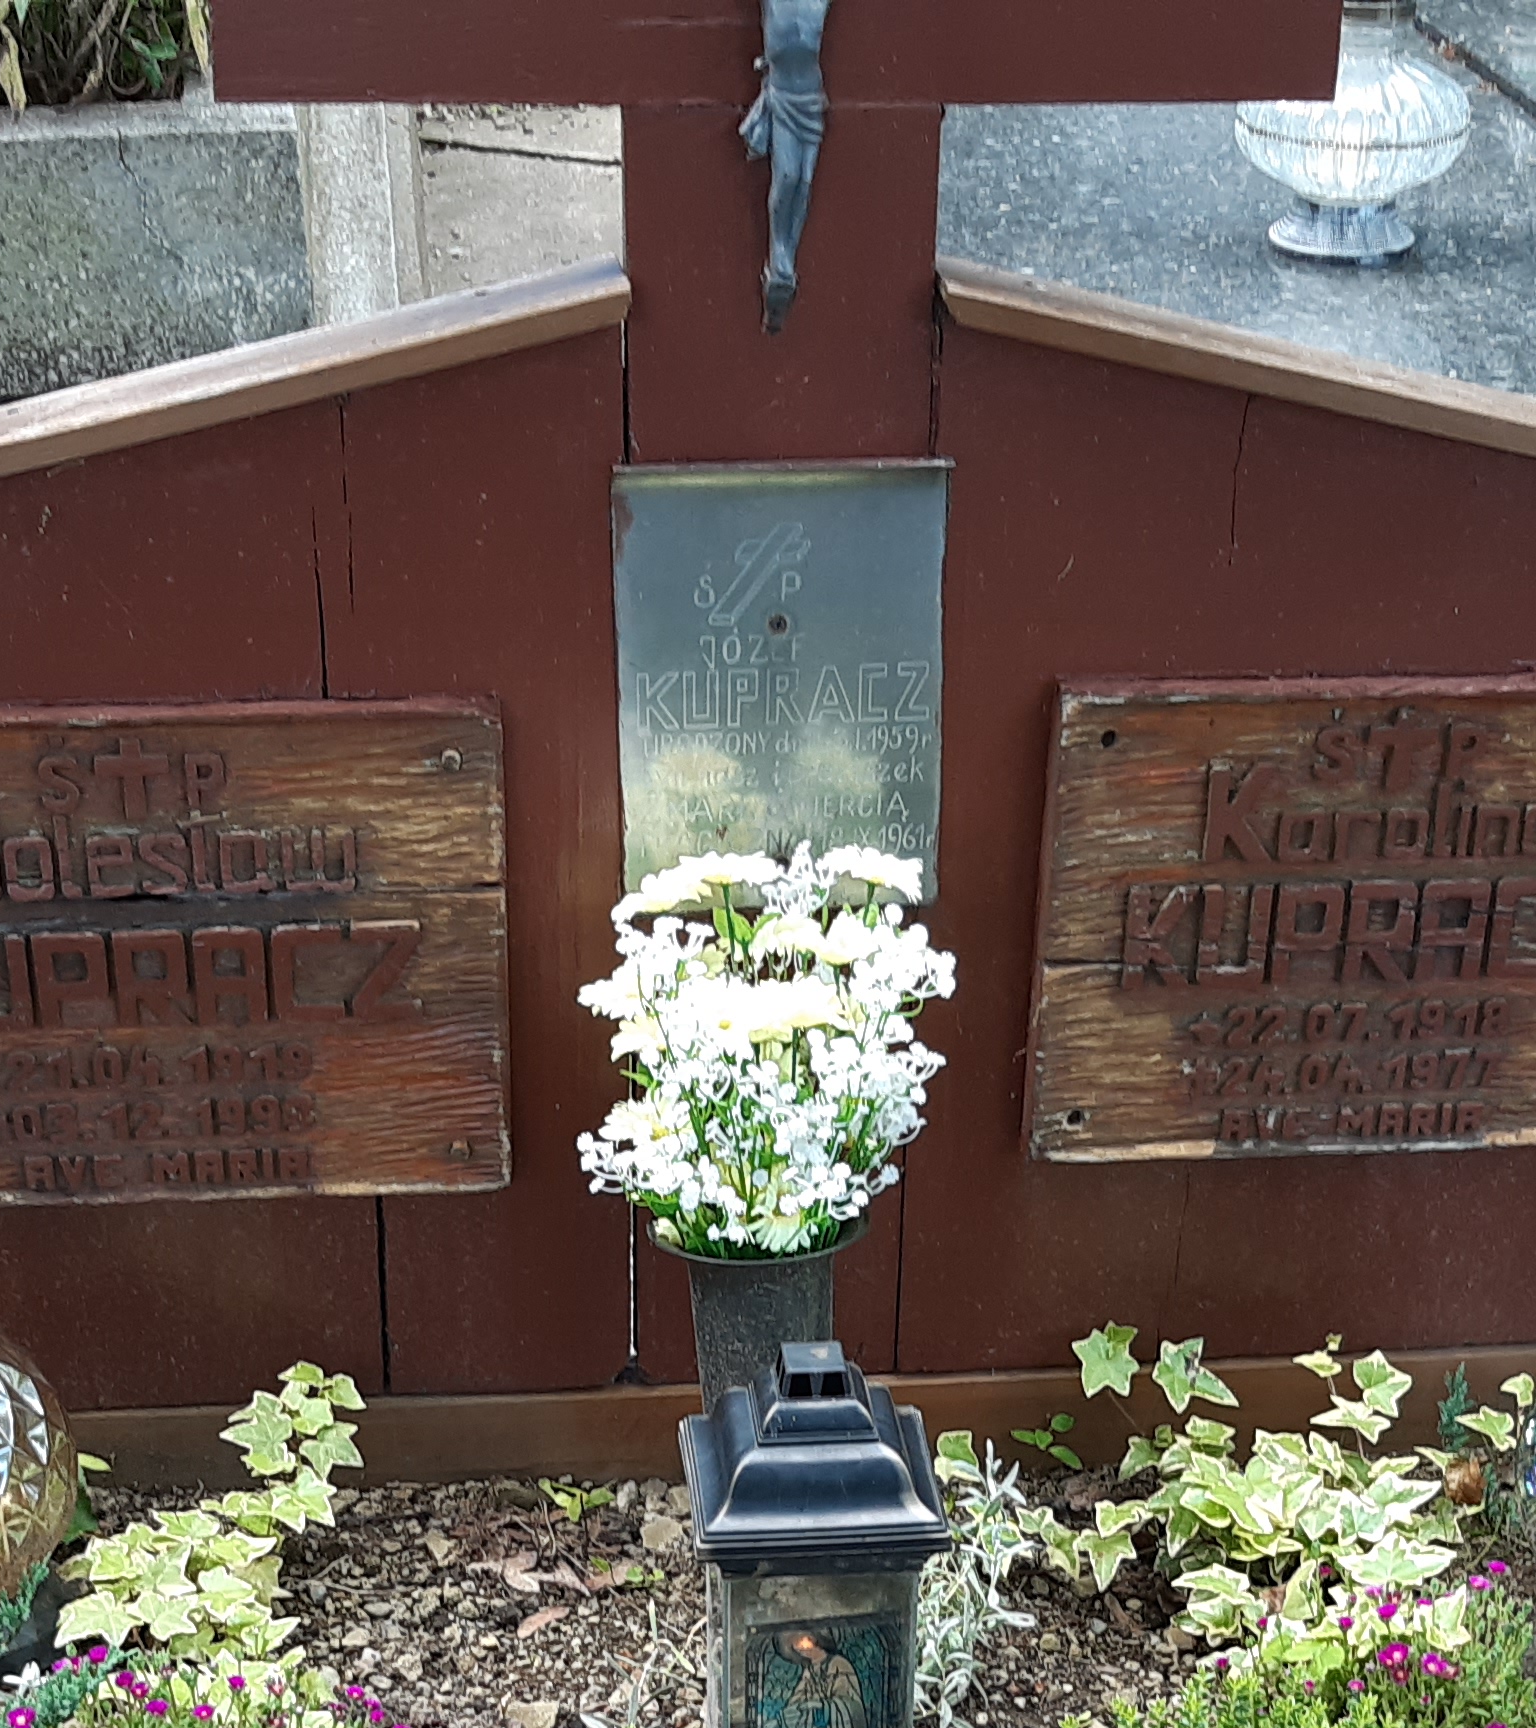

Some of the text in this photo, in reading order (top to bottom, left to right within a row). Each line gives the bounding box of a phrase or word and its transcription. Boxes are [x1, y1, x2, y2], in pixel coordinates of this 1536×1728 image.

[636, 662, 930, 731] KUPRACZ
[1338, 1102, 1485, 1138] MARIA
[24, 1149, 312, 1192] AVE MARIA
